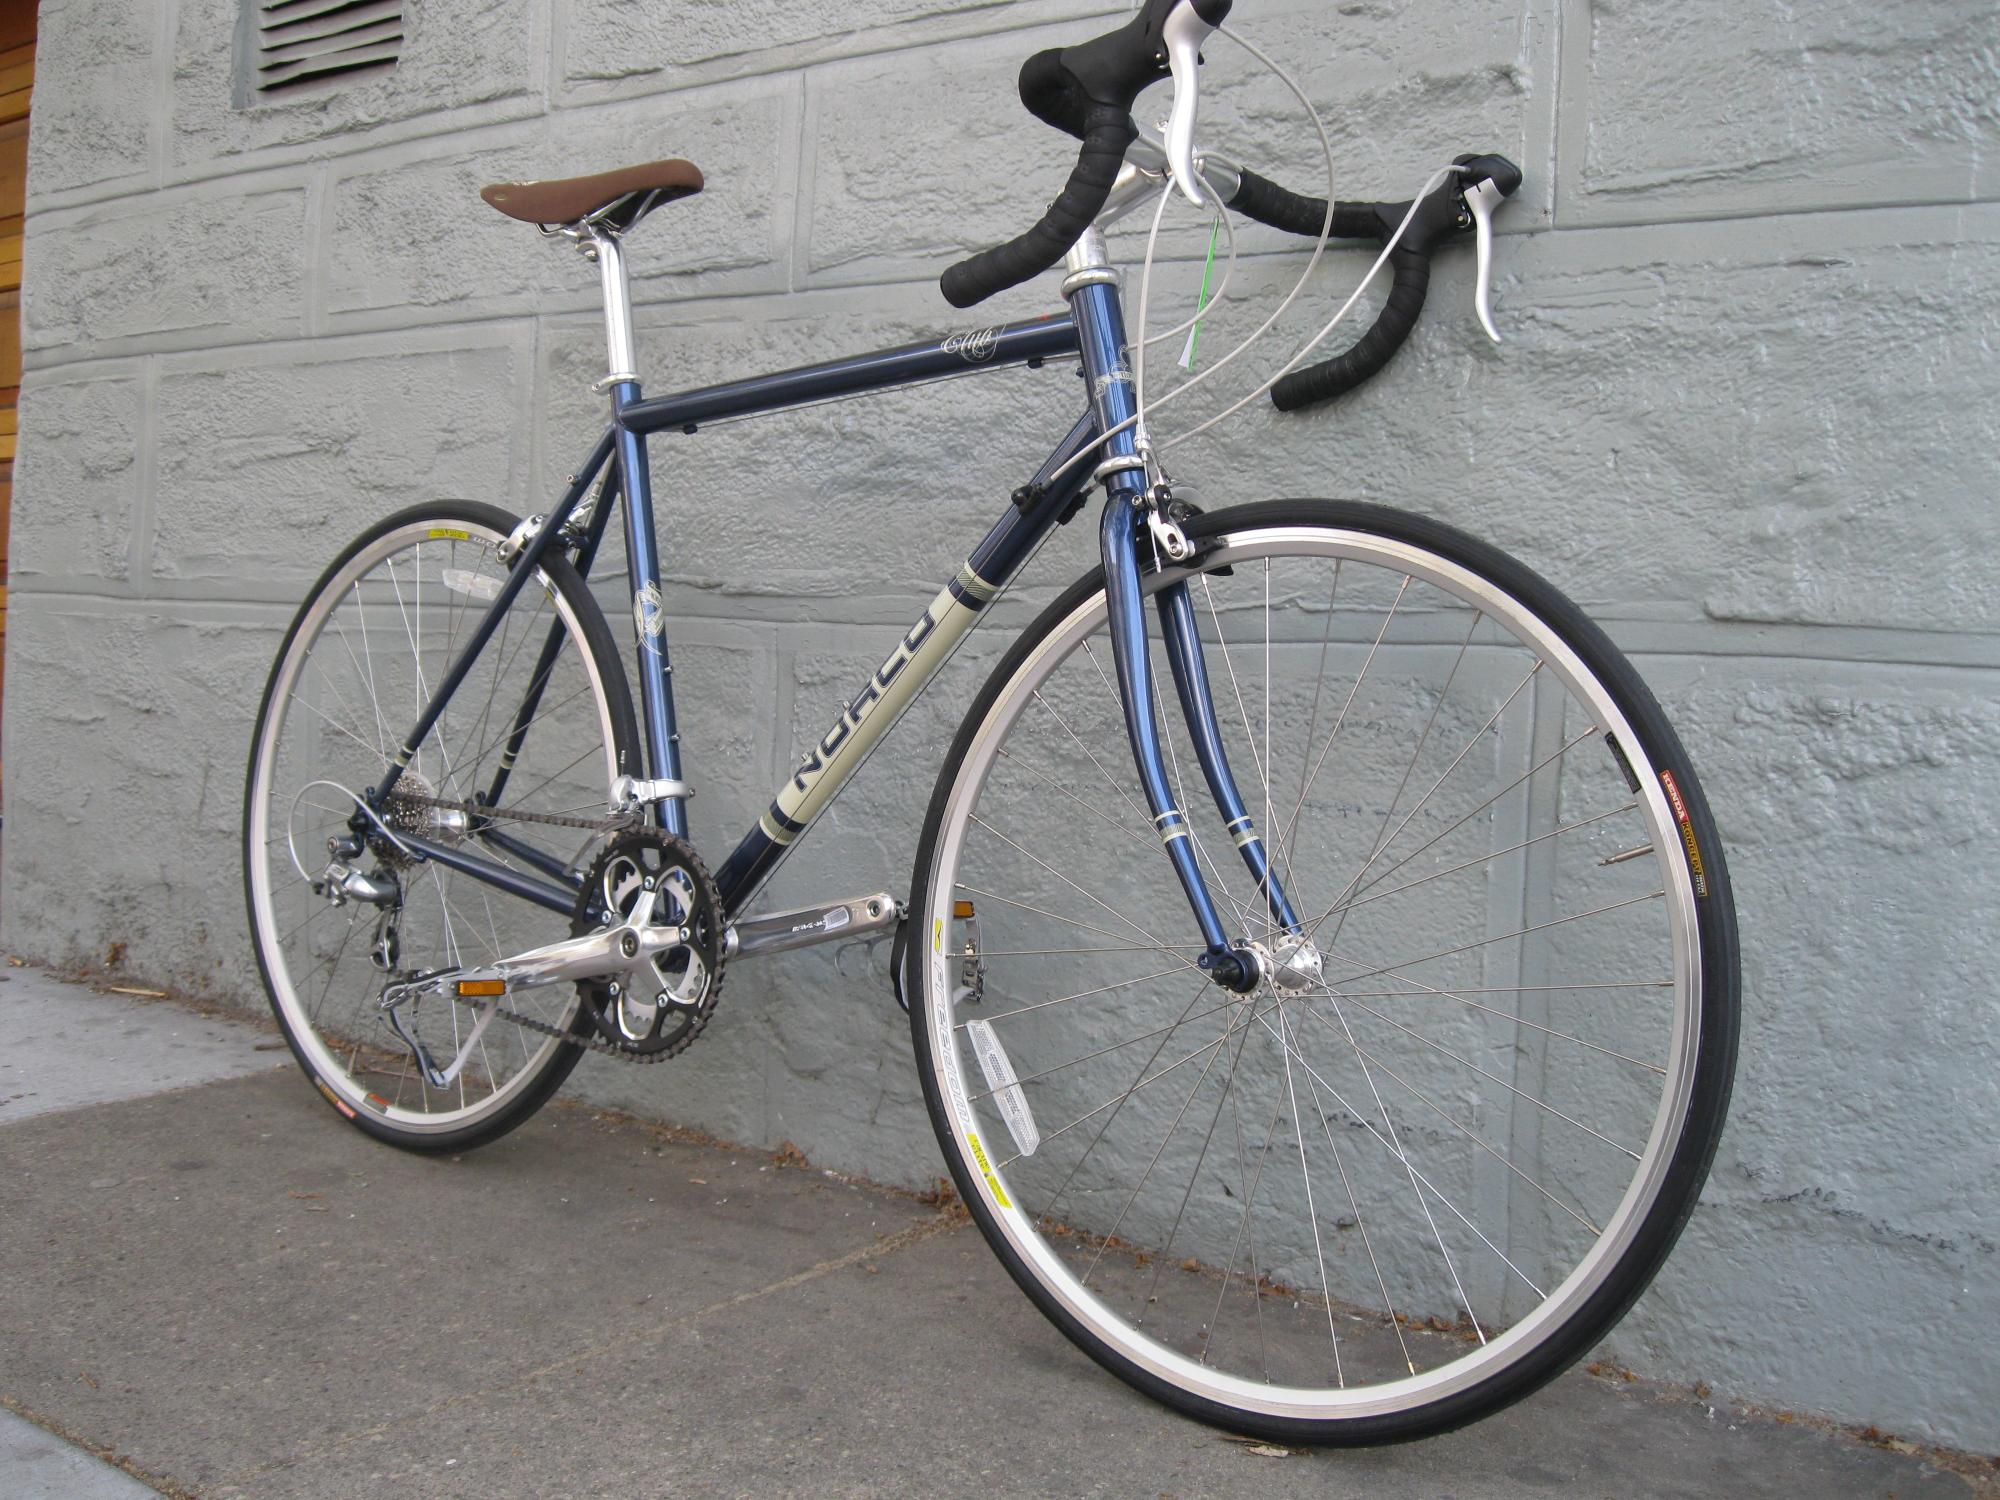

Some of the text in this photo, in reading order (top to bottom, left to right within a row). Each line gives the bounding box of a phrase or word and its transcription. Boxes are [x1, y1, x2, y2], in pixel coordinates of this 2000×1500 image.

[794, 610, 936, 793] NORCO
[1662, 772, 1687, 821] KENDA
[933, 962, 970, 1124] Freedom
